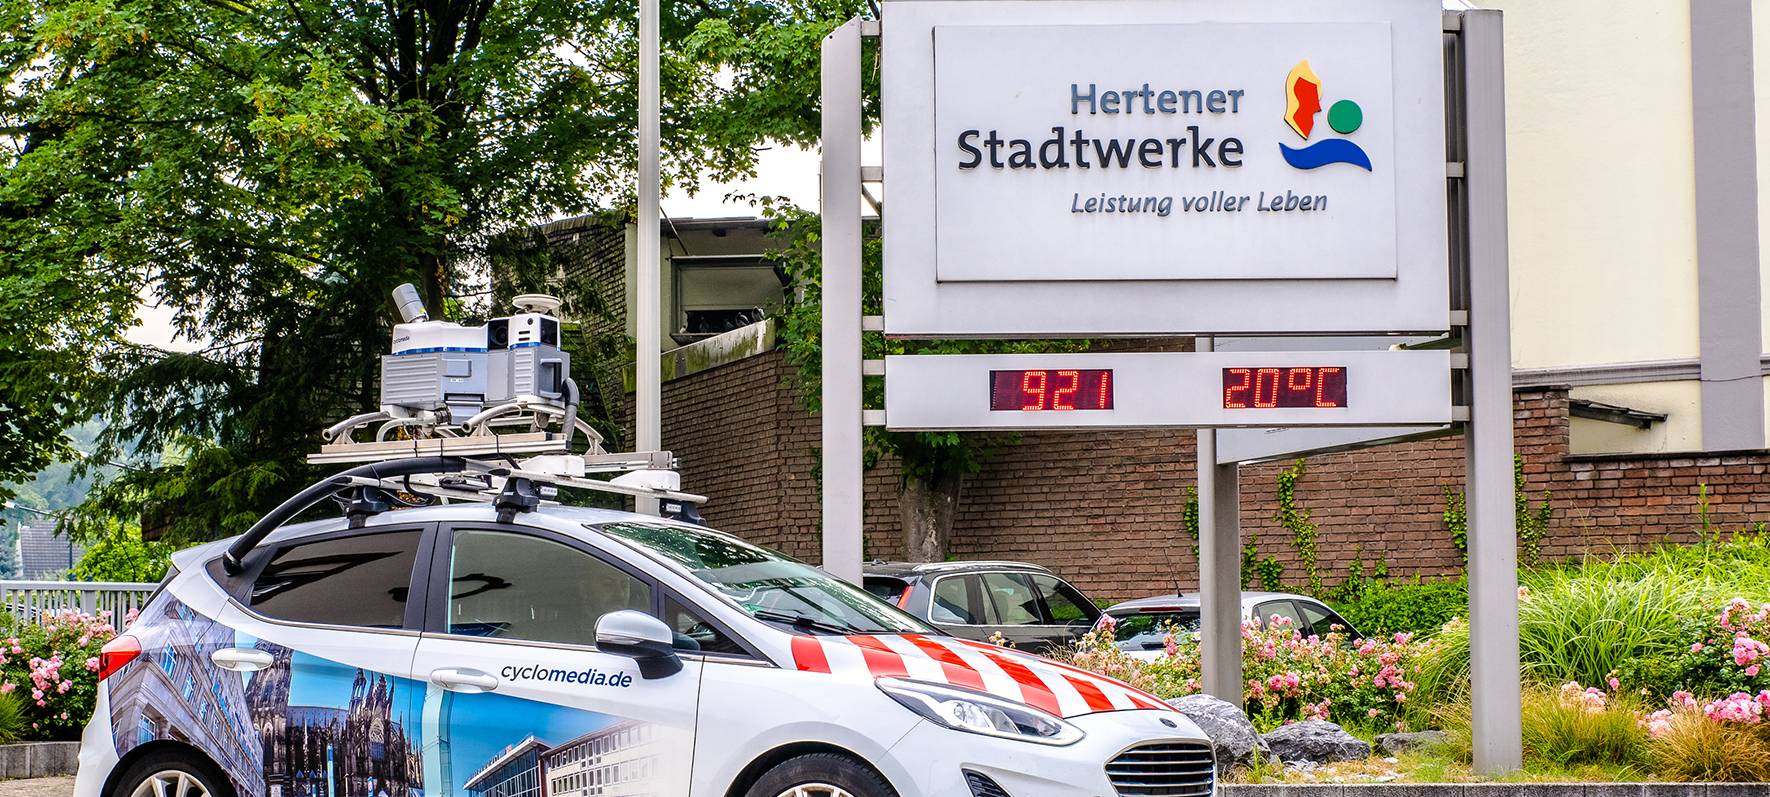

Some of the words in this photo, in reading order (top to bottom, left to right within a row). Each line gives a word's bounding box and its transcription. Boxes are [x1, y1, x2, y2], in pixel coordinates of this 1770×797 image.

[1070, 83, 1244, 115] Hertener
[957, 125, 1244, 170] Stadtwerke
[1070, 193, 1172, 217] Leistung
[1181, 191, 1250, 213] voller
[1257, 190, 1328, 212] Leben
[501, 664, 632, 688] cyclomedia.de
